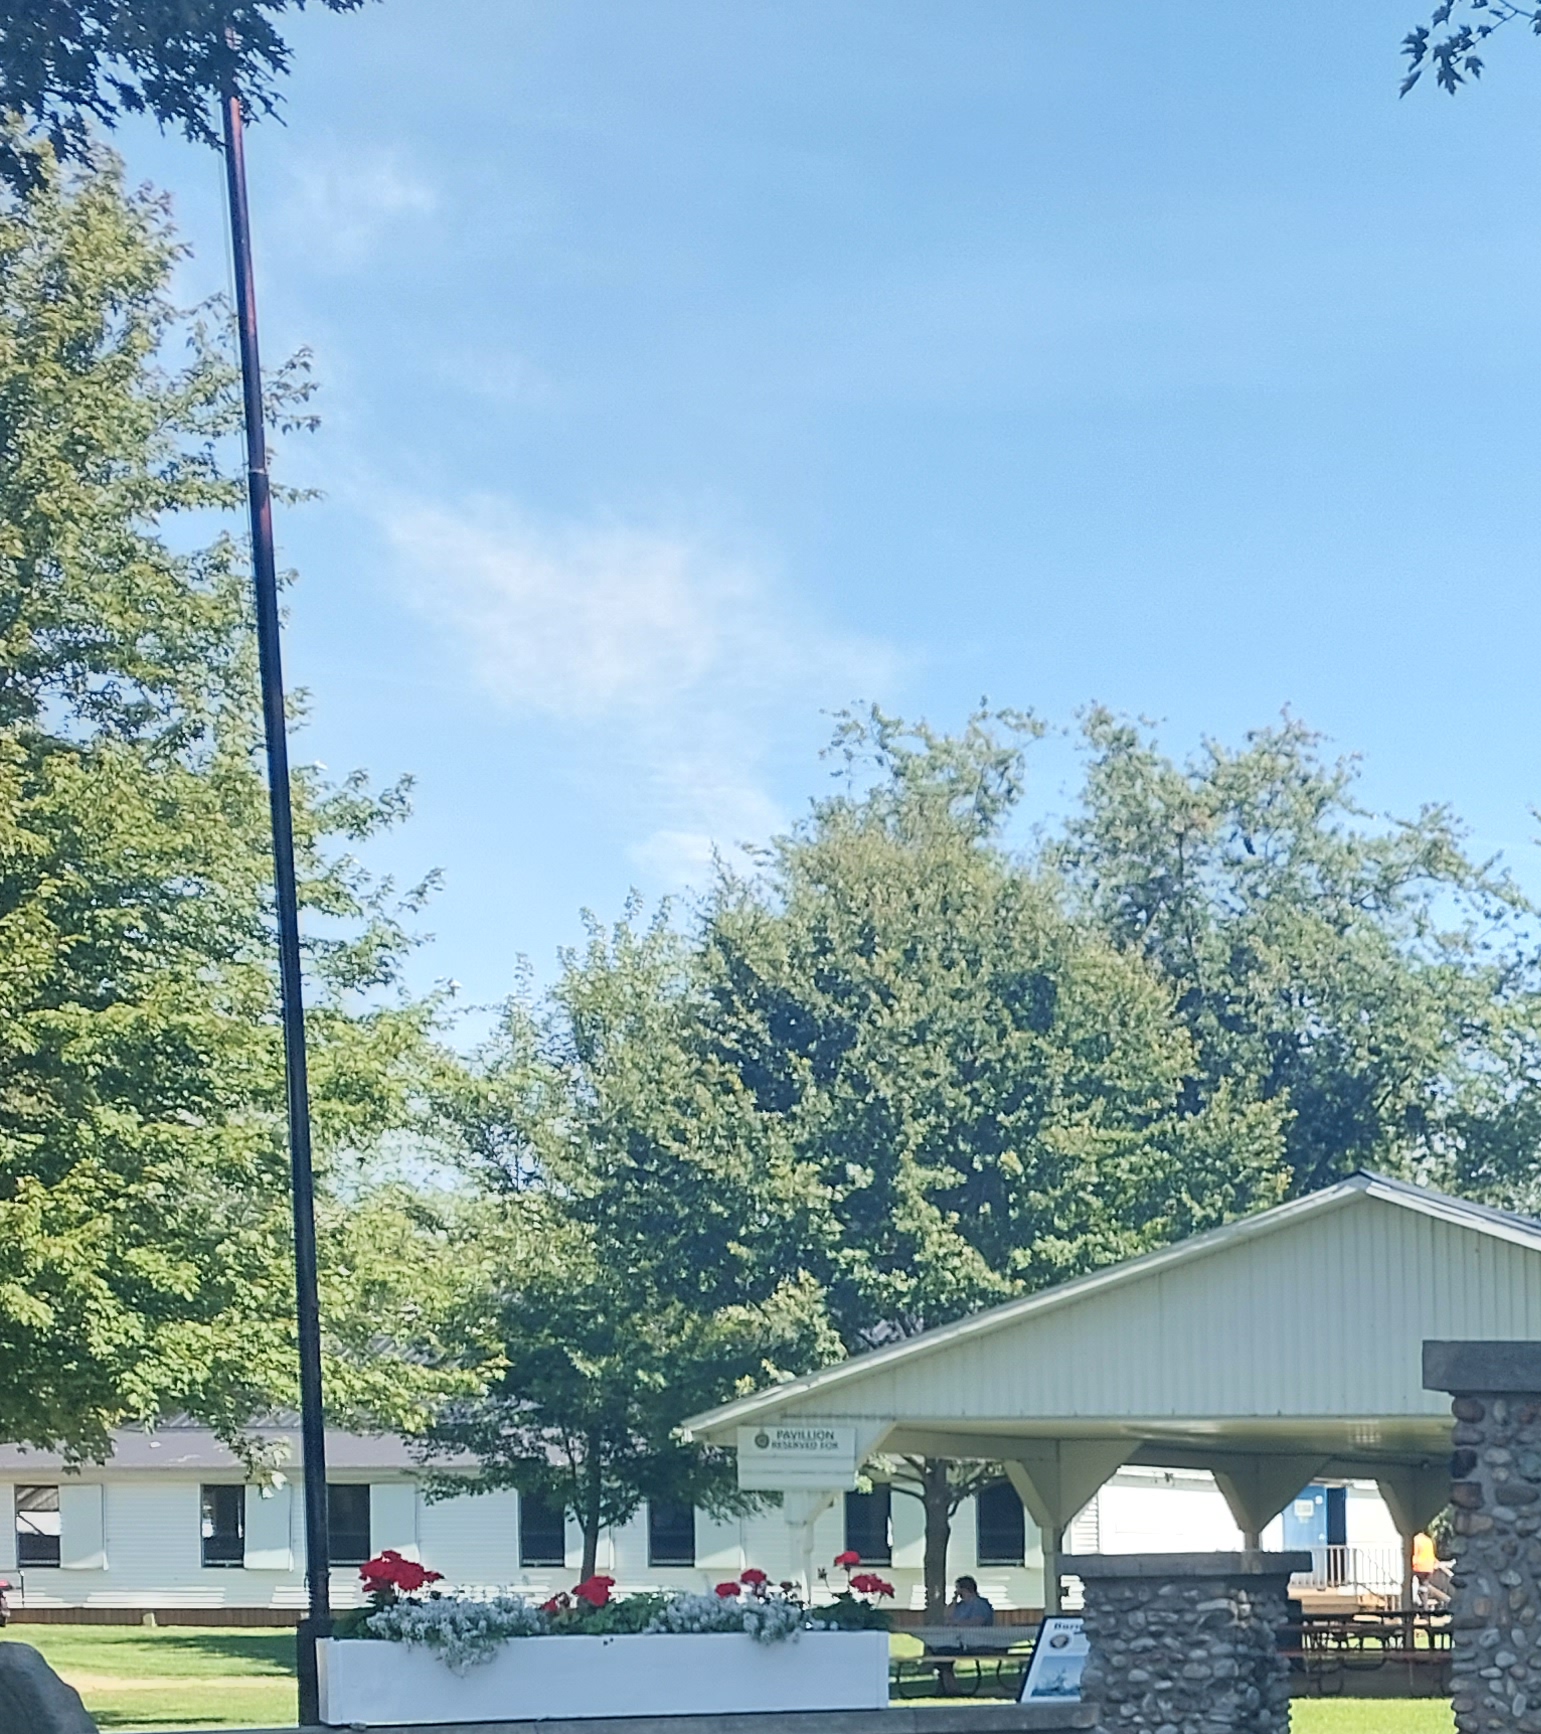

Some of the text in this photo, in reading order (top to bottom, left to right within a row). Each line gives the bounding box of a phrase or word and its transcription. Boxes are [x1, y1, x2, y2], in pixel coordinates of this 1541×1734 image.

[776, 1430, 835, 1441] PAVILLION
[771, 1441, 839, 1450] RESERVED FOR
